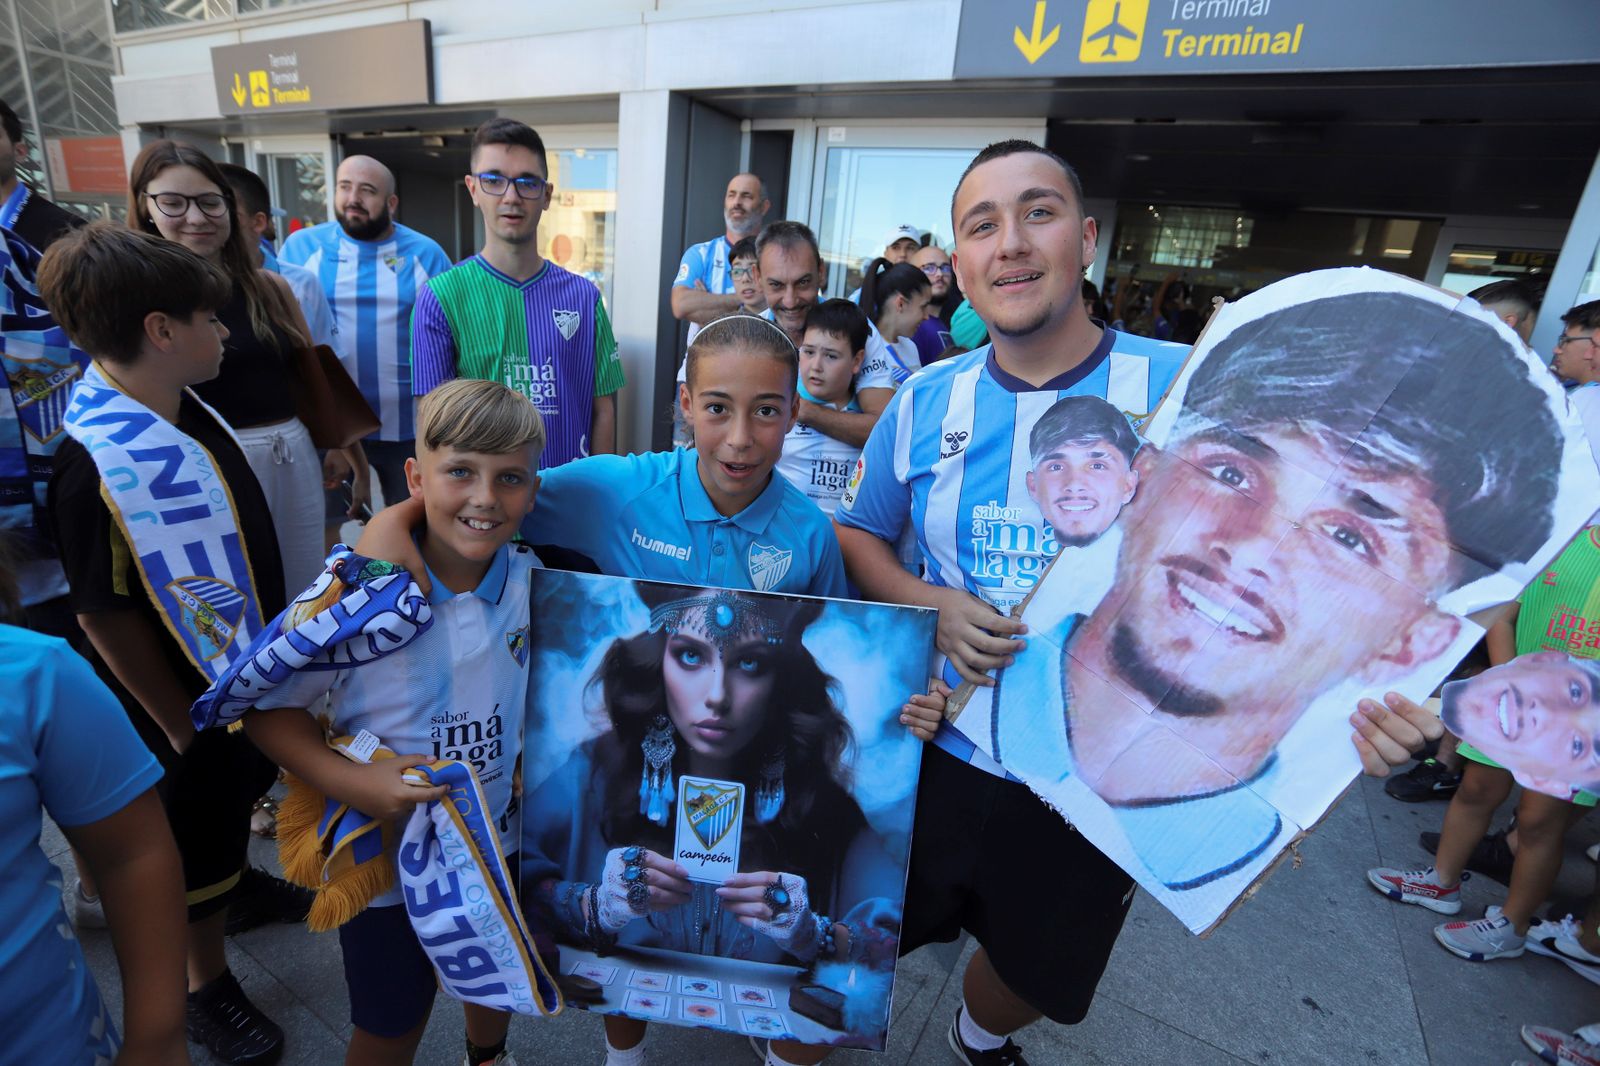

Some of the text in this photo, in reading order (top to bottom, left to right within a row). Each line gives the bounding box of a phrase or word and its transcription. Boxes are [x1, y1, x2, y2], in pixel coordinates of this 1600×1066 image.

[1162, 23, 1304, 58] Terminal
[272, 86, 310, 104] Terminal
[513, 357, 556, 381] má
[811, 468, 847, 492] laga
[209, 488, 227, 513] LO
[972, 501, 1021, 520] sabor
[972, 519, 987, 536] a
[632, 528, 691, 561] hummel
[971, 537, 1052, 588] lag
[430, 711, 469, 725] sabor
[431, 703, 504, 748] a má
[439, 829, 475, 877] 2024
[680, 850, 733, 867] campeón
[465, 884, 519, 969] ASCENSO
